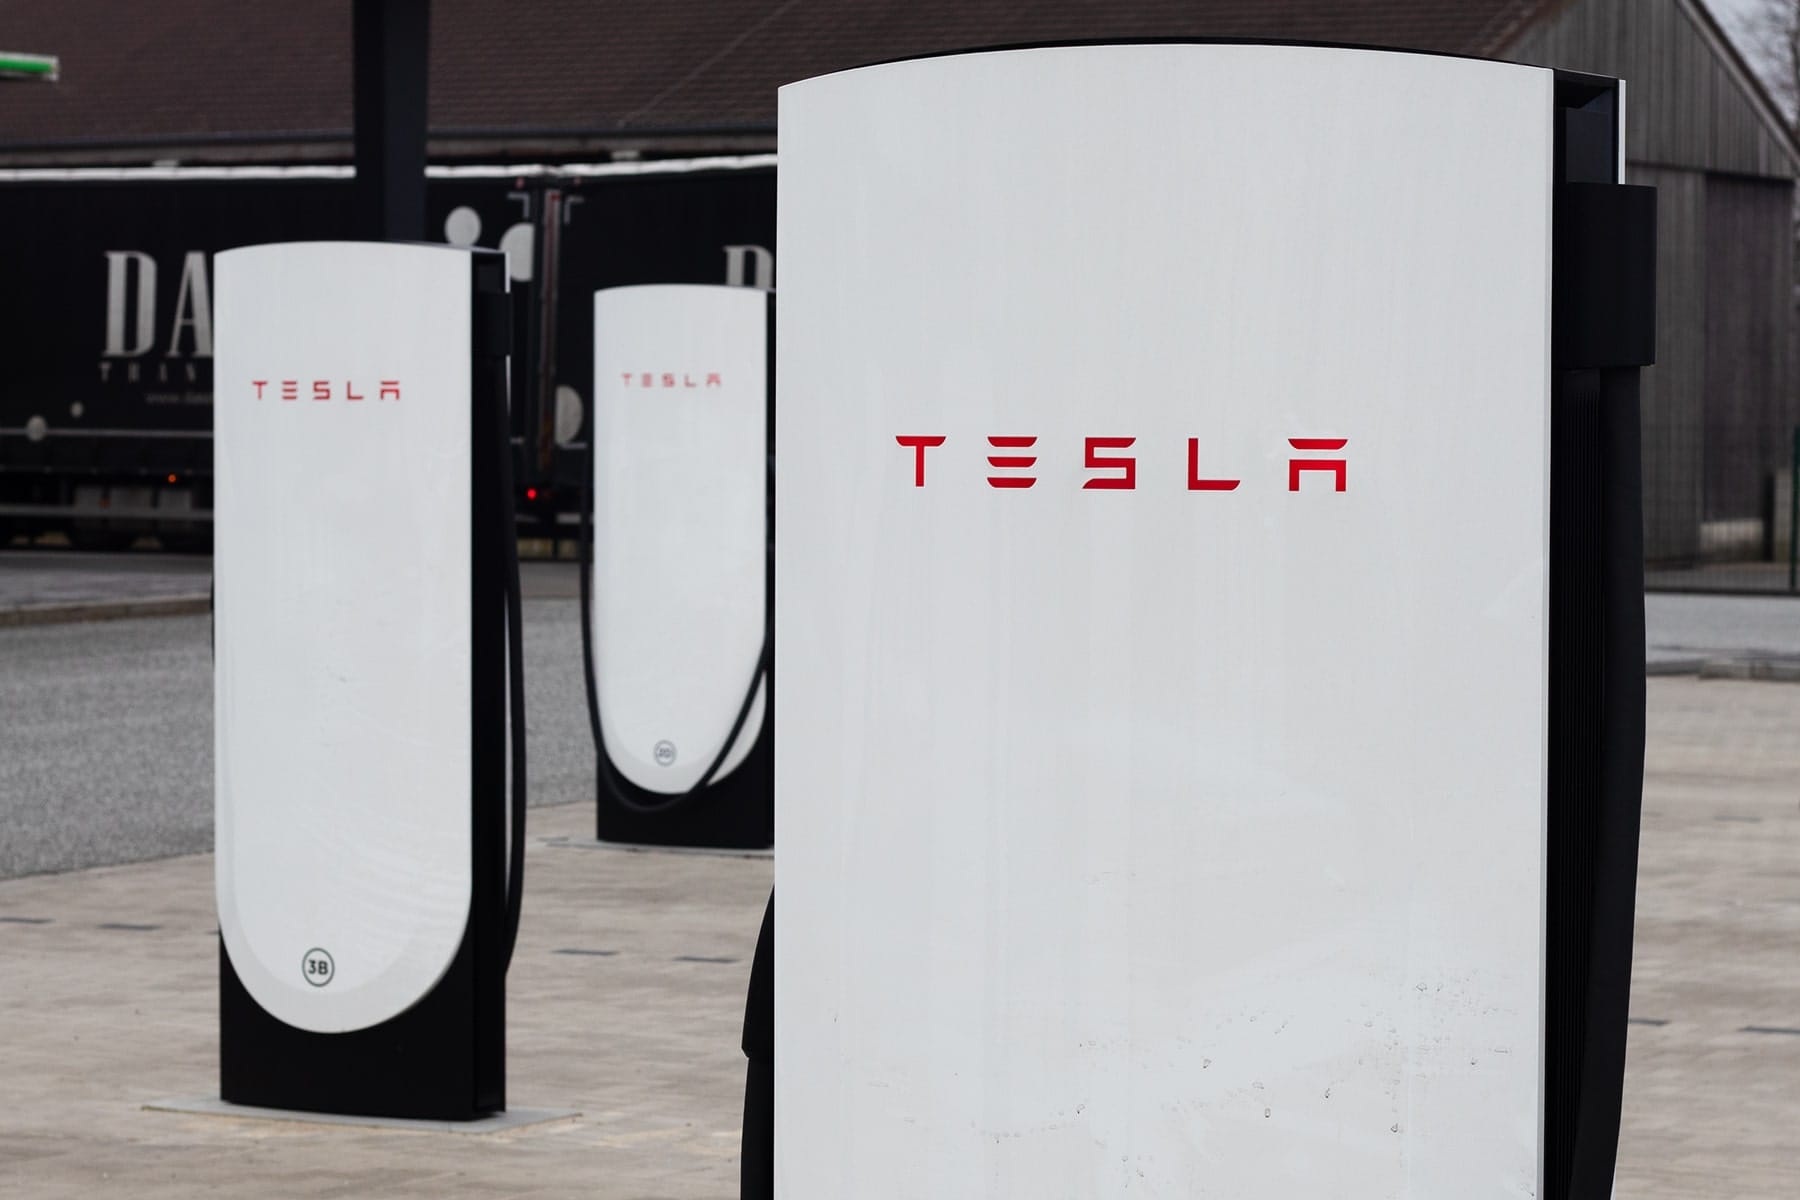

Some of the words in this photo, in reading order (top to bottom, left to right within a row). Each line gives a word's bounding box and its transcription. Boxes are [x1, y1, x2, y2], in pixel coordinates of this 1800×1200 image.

[622, 373, 721, 388] TESLA
[252, 380, 400, 401] TESLA
[895, 434, 1349, 493] TESLA
[308, 960, 328, 975] 3B
